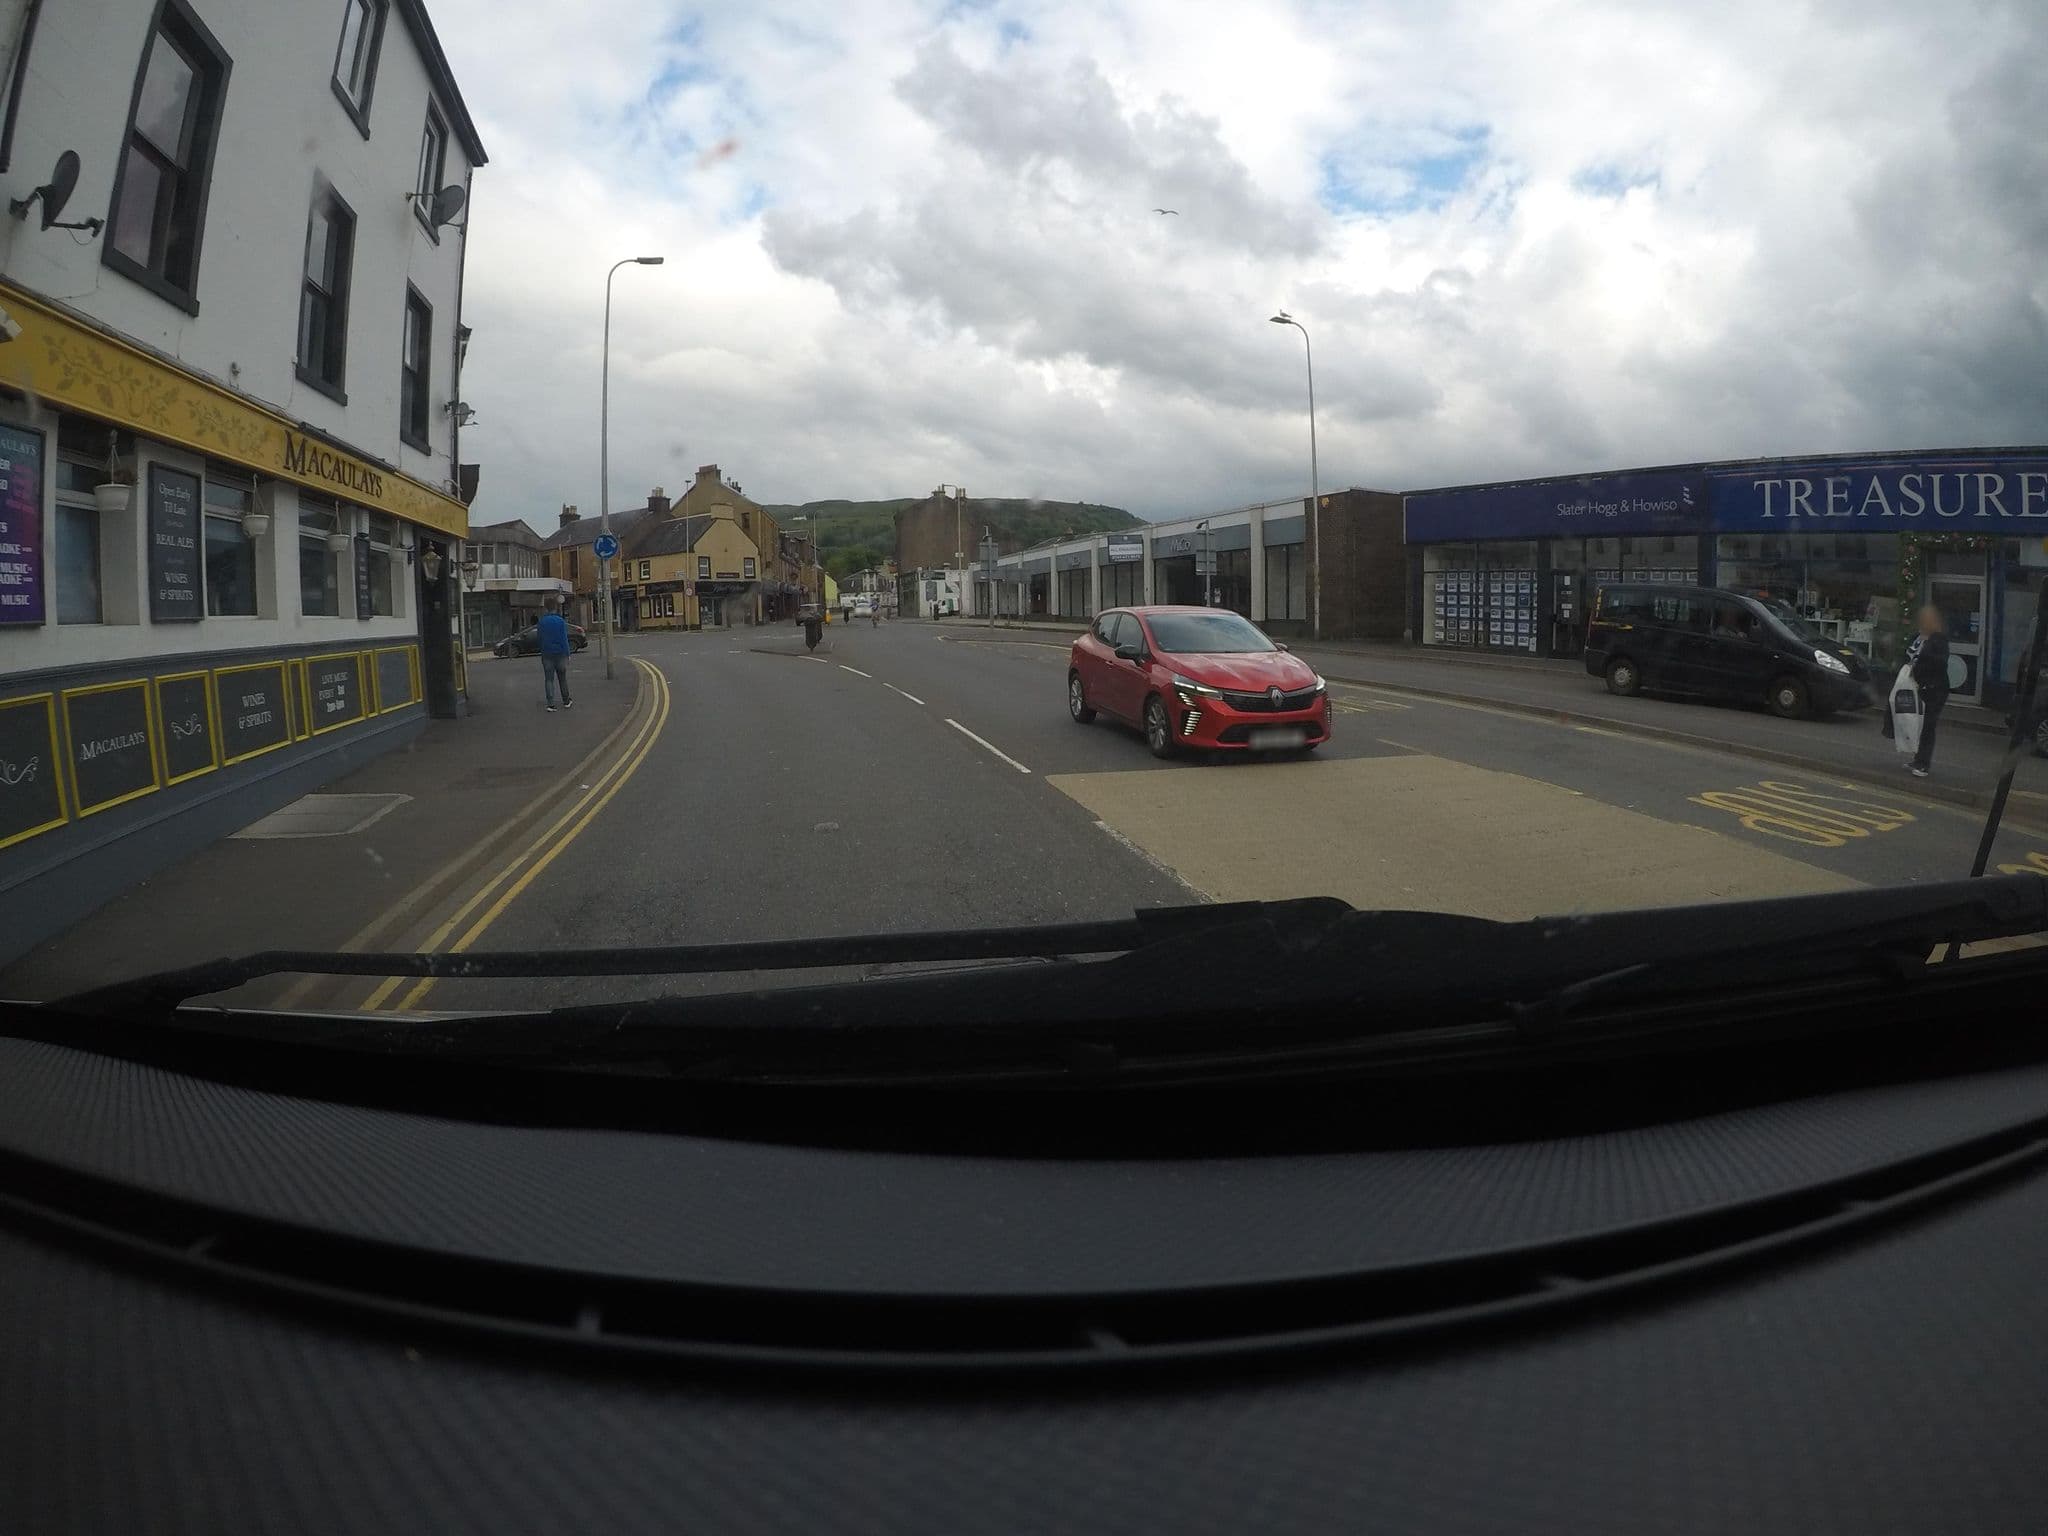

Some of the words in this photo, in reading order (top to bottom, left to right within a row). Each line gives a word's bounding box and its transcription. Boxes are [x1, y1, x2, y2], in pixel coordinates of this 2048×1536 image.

[283, 429, 383, 498] MACAULAYS
[1753, 472, 2048, 519] TREASURE
[1556, 502, 1585, 517] Slater
[1588, 501, 1618, 517] Hogg
[1620, 499, 1630, 513] &
[156, 533, 174, 548] REAL
[176, 536, 194, 550] ALES
[164, 572, 188, 585] WINES
[1, 594, 30, 606] MUSIC
[167, 589, 194, 601] SPIRITS
[241, 692, 266, 708] WINES
[246, 710, 273, 729] SPIRITS
[79, 731, 146, 762] MACAULAYS
